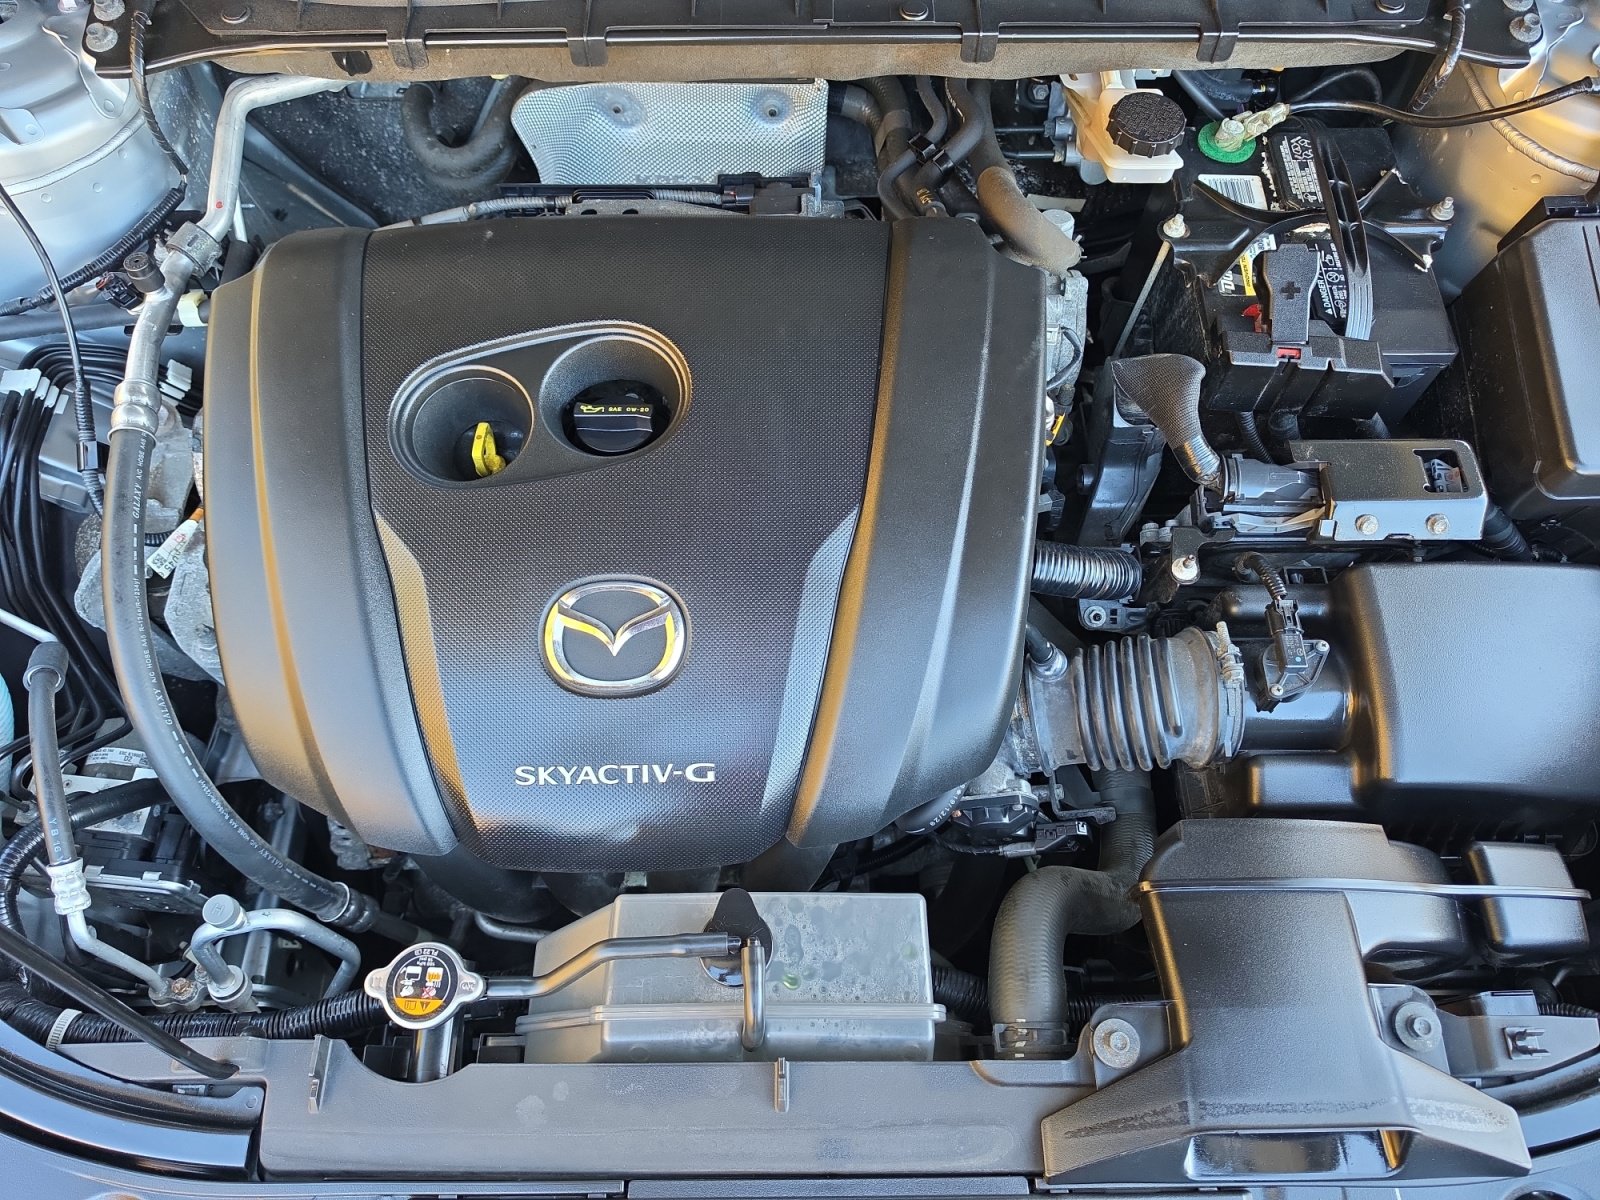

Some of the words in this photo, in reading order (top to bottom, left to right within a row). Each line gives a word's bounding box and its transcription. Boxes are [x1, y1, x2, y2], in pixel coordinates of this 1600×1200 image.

[1317, 279, 1333, 309] DANGER
[132, 483, 142, 519] GALAXY
[137, 450, 145, 467] HOSE
[144, 650, 152, 669] HOSE
[154, 688, 172, 725] GALAXY
[515, 762, 716, 785] SKYACTIV-G
